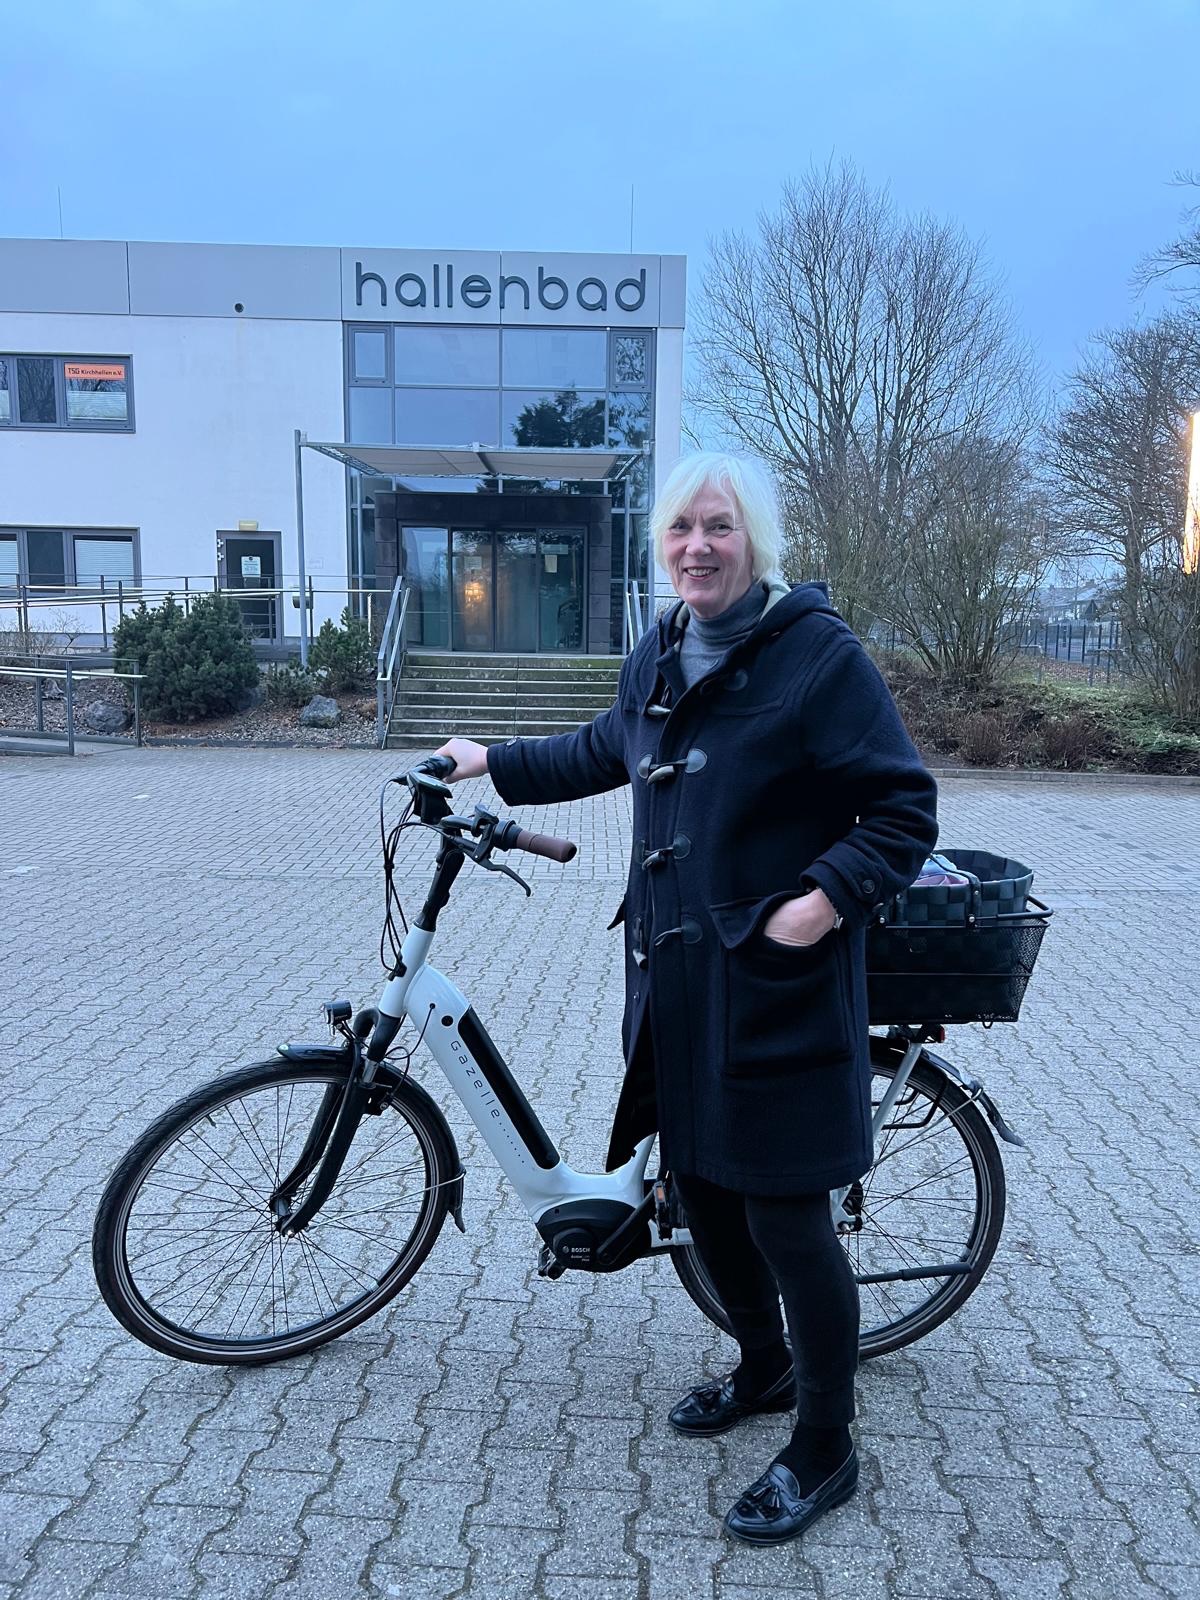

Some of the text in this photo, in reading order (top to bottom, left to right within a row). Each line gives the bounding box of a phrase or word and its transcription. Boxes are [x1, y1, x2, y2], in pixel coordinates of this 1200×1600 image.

[354, 261, 646, 312] hallenbad
[67, 367, 80, 375] TSG
[450, 1040, 500, 1119] Gazelle
